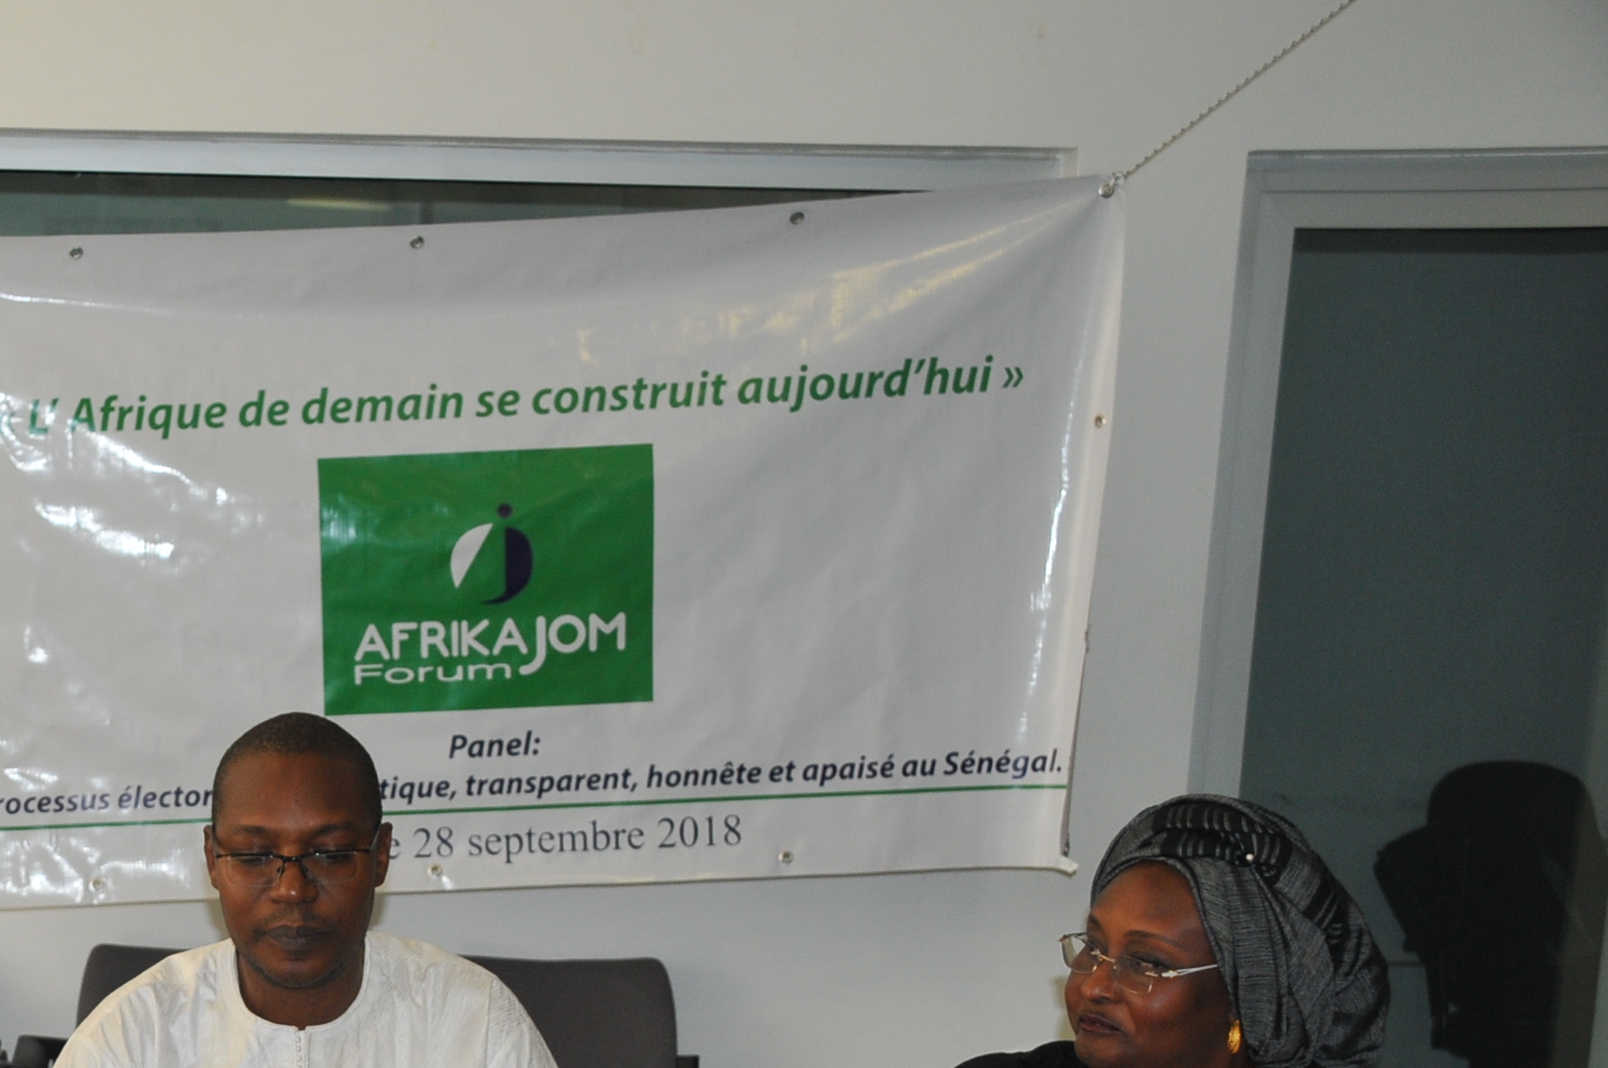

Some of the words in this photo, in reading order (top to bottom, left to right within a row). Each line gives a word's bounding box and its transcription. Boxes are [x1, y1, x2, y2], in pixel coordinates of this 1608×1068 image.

[69, 393, 227, 439] Afrique
[238, 389, 290, 428] de
[301, 383, 464, 425] demain
[475, 389, 521, 418] se
[531, 370, 727, 415] construit
[354, 611, 627, 676] AFRIKAJOM
[354, 662, 512, 685] Forum
[448, 730, 541, 759] Panel:
[117, 786, 213, 809] élector
[466, 772, 639, 799] transparent,
[646, 762, 762, 789] honnête
[769, 760, 796, 783] et
[802, 753, 896, 786] apaisé
[902, 758, 937, 777] au
[943, 747, 1063, 779] Sénégal.
[413, 826, 455, 858] 28
[467, 819, 645, 863] septembre
[657, 814, 743, 848] 2018
